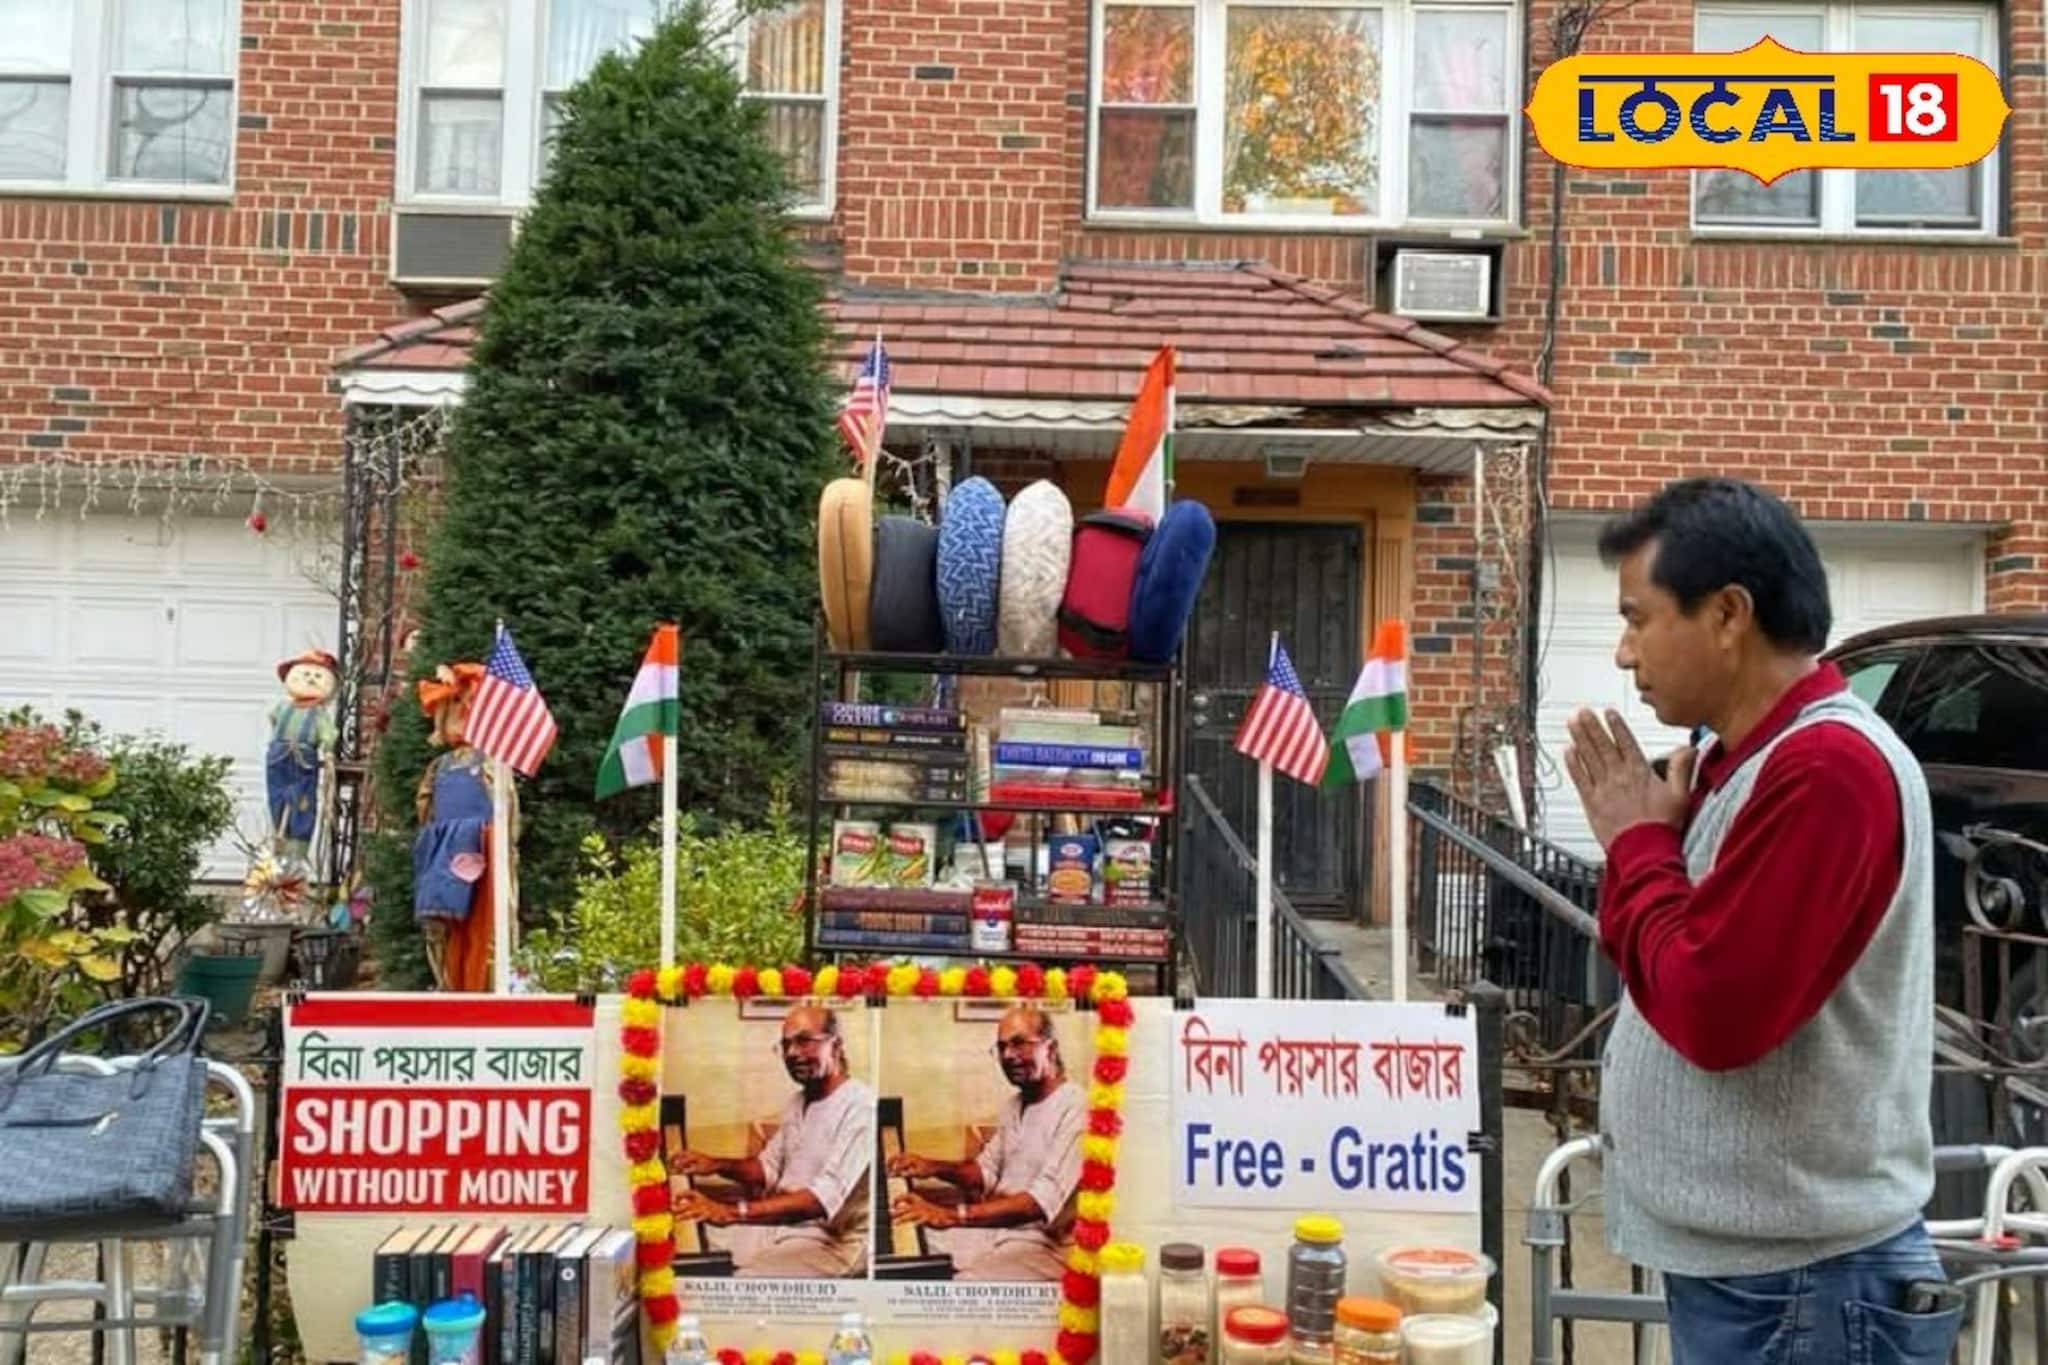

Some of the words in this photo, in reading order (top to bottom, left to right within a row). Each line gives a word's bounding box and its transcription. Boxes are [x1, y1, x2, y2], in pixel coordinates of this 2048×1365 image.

[298, 1031, 364, 1081] বিনা
[373, 1046, 477, 1085] পয়সার
[486, 1046, 583, 1082] বাজার
[1182, 1016, 1247, 1096] বিনা
[1258, 1030, 1362, 1097] পয়সার
[1370, 1034, 1465, 1100] বাজার
[294, 1098, 581, 1156] SHOPPING
[1186, 1123, 1285, 1189] Free
[1330, 1125, 1466, 1192] Gratis
[293, 1168, 449, 1205] WITHOUT
[459, 1168, 578, 1206] MONEY
[734, 1282, 837, 1296] CHOWDHURY
[903, 1285, 948, 1297] SALIL
[954, 1286, 1058, 1298] CHOWDHURY
